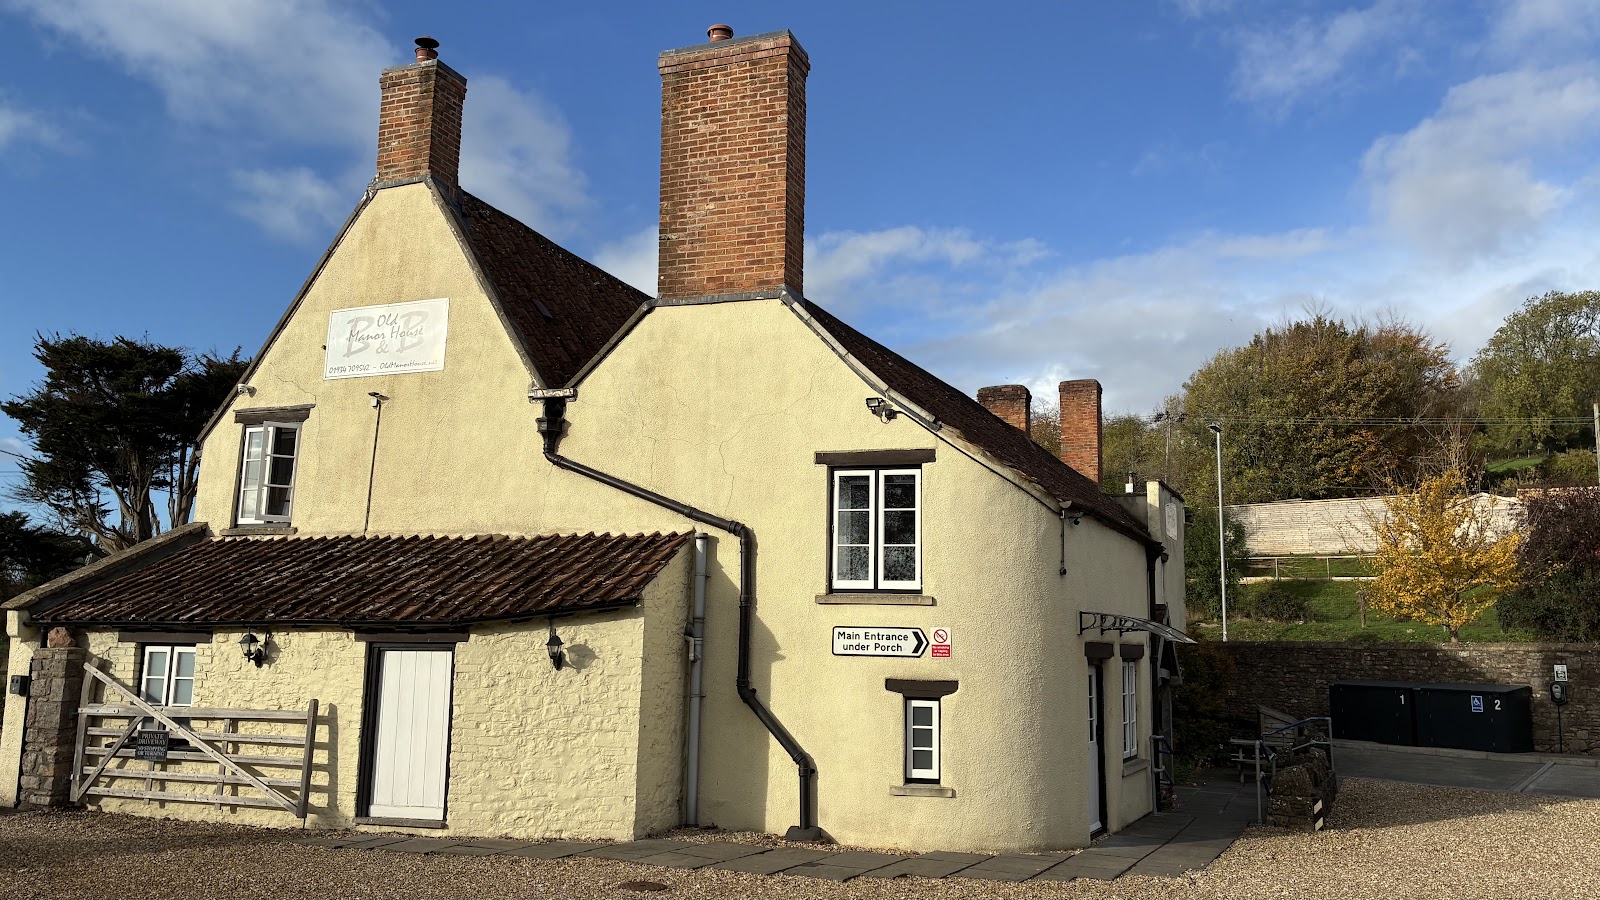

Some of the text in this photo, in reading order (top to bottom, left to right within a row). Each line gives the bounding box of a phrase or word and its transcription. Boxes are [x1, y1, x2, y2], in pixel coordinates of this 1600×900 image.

[377, 312, 399, 328] Old
[342, 310, 429, 358] B & B
[348, 326, 423, 343] Manor House
[329, 365, 347, 374] 01934
[837, 631, 909, 641] Main Entrance
[842, 642, 903, 652] under Porch
[1399, 694, 1406, 705] 1
[1494, 699, 1502, 711] 2
